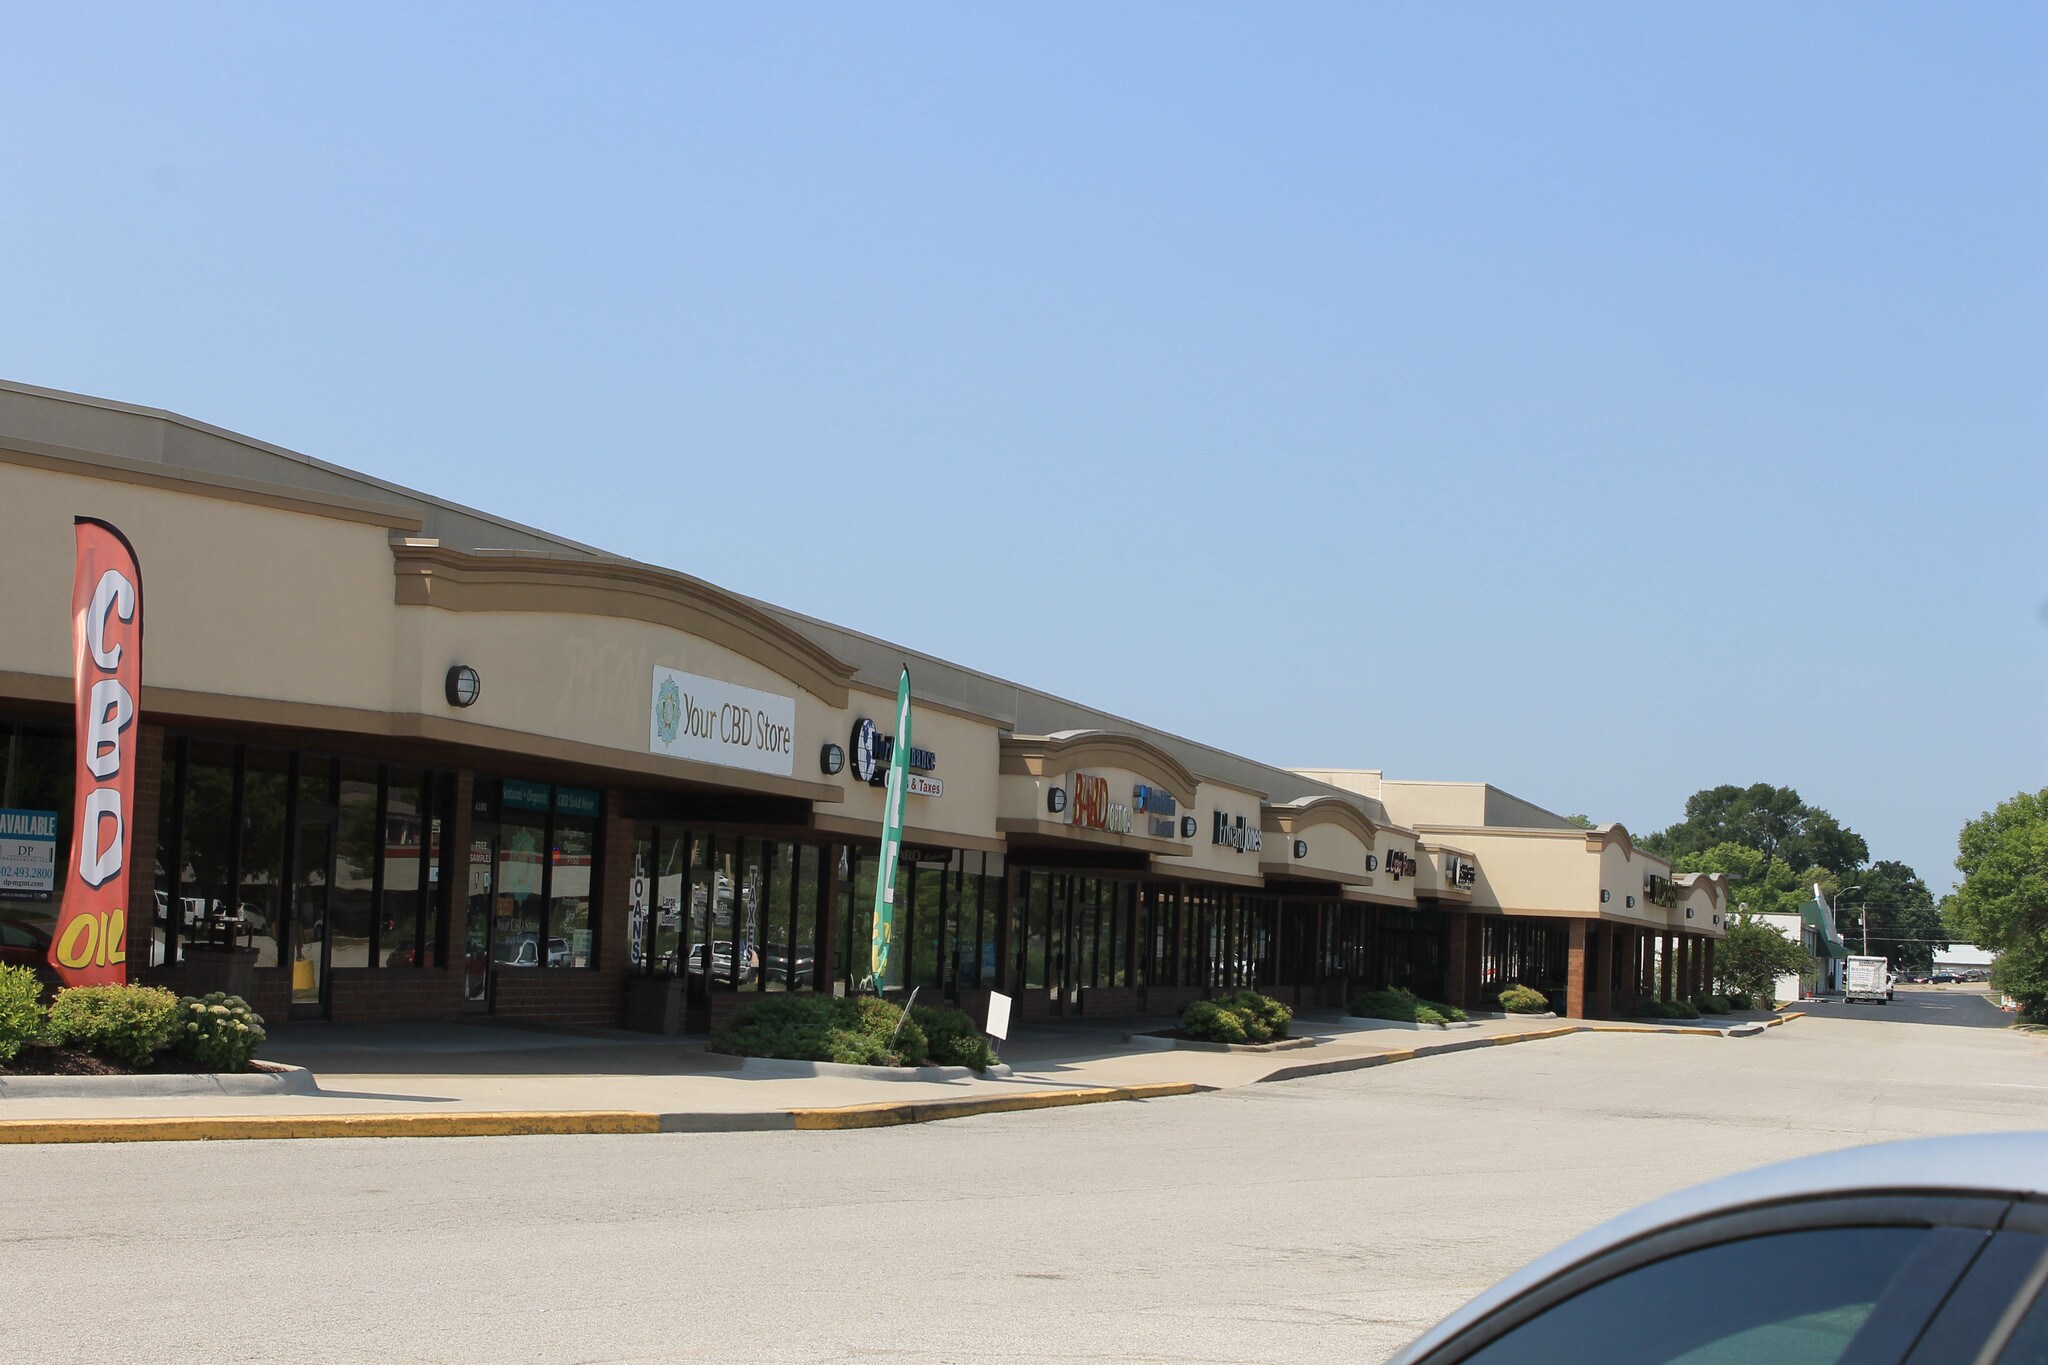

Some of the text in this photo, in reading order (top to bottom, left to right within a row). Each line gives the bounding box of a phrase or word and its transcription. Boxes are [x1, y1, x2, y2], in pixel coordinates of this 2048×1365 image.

[79, 568, 135, 888] CBD
[683, 693, 791, 754] Your CBD Store
[919, 779, 940, 795] Taxes
[527, 789, 548, 806] Organic
[557, 793, 569, 807] CBD
[1073, 773, 1109, 829] BARD
[0, 814, 55, 836] AVAILABLE
[1217, 812, 1244, 849] Edward
[1243, 816, 1262, 853] Jones
[18, 845, 34, 856] DP
[475, 841, 488, 850] FREE
[470, 853, 492, 863] SAMPLES
[0, 866, 53, 879] 02.493.2800
[631, 853, 645, 964] LOANS
[745, 866, 759, 962] TAXES
[510, 918, 524, 932] CBD
[57, 908, 127, 969] OIL
